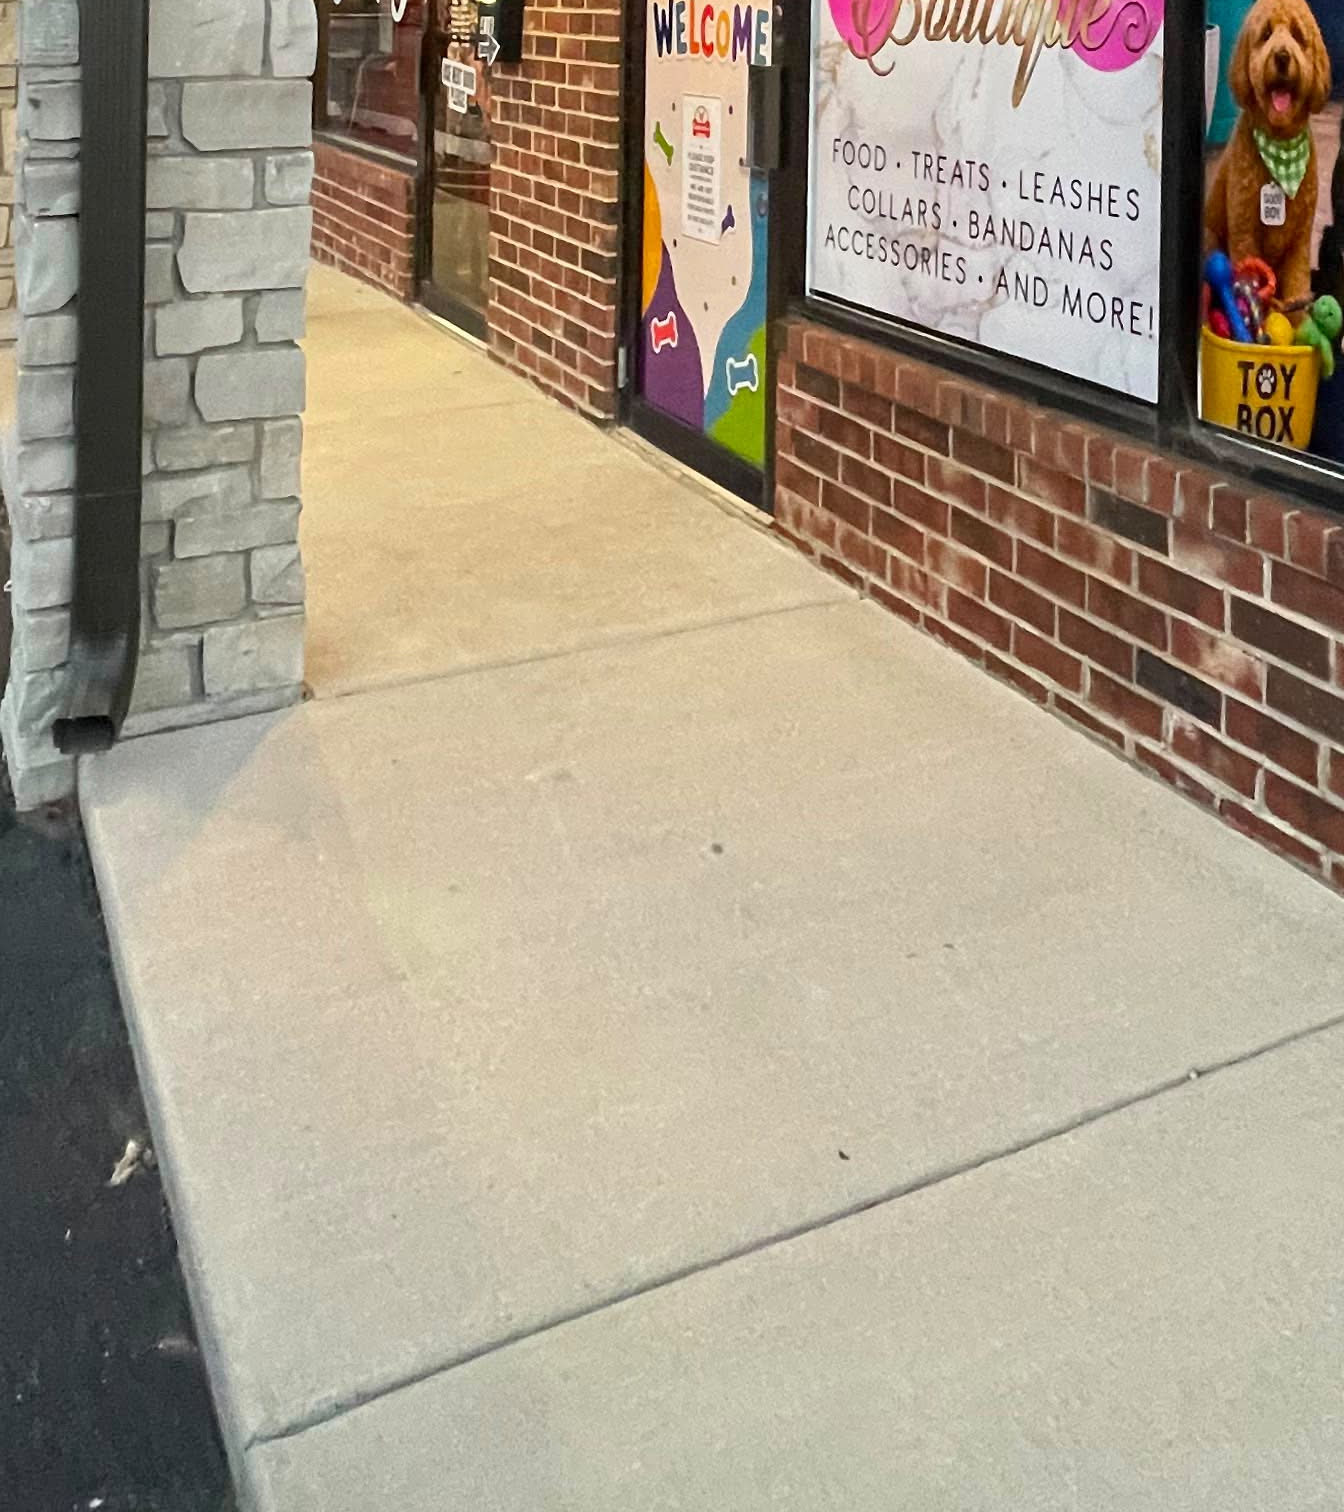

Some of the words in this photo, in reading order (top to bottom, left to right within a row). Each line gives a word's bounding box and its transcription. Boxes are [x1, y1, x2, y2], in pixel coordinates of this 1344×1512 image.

[832, 138, 887, 172] FOOD
[911, 150, 990, 191] TREATS
[1019, 169, 1140, 222] LEASHES
[848, 185, 942, 230] COLLARS
[969, 210, 1113, 270] BANDANAS
[824, 223, 966, 284] ACCESSORIES
[995, 266, 1048, 307] AND
[1062, 284, 1154, 339] MORE!
[1237, 361, 1297, 401] TOY
[1237, 403, 1295, 443] BOX
